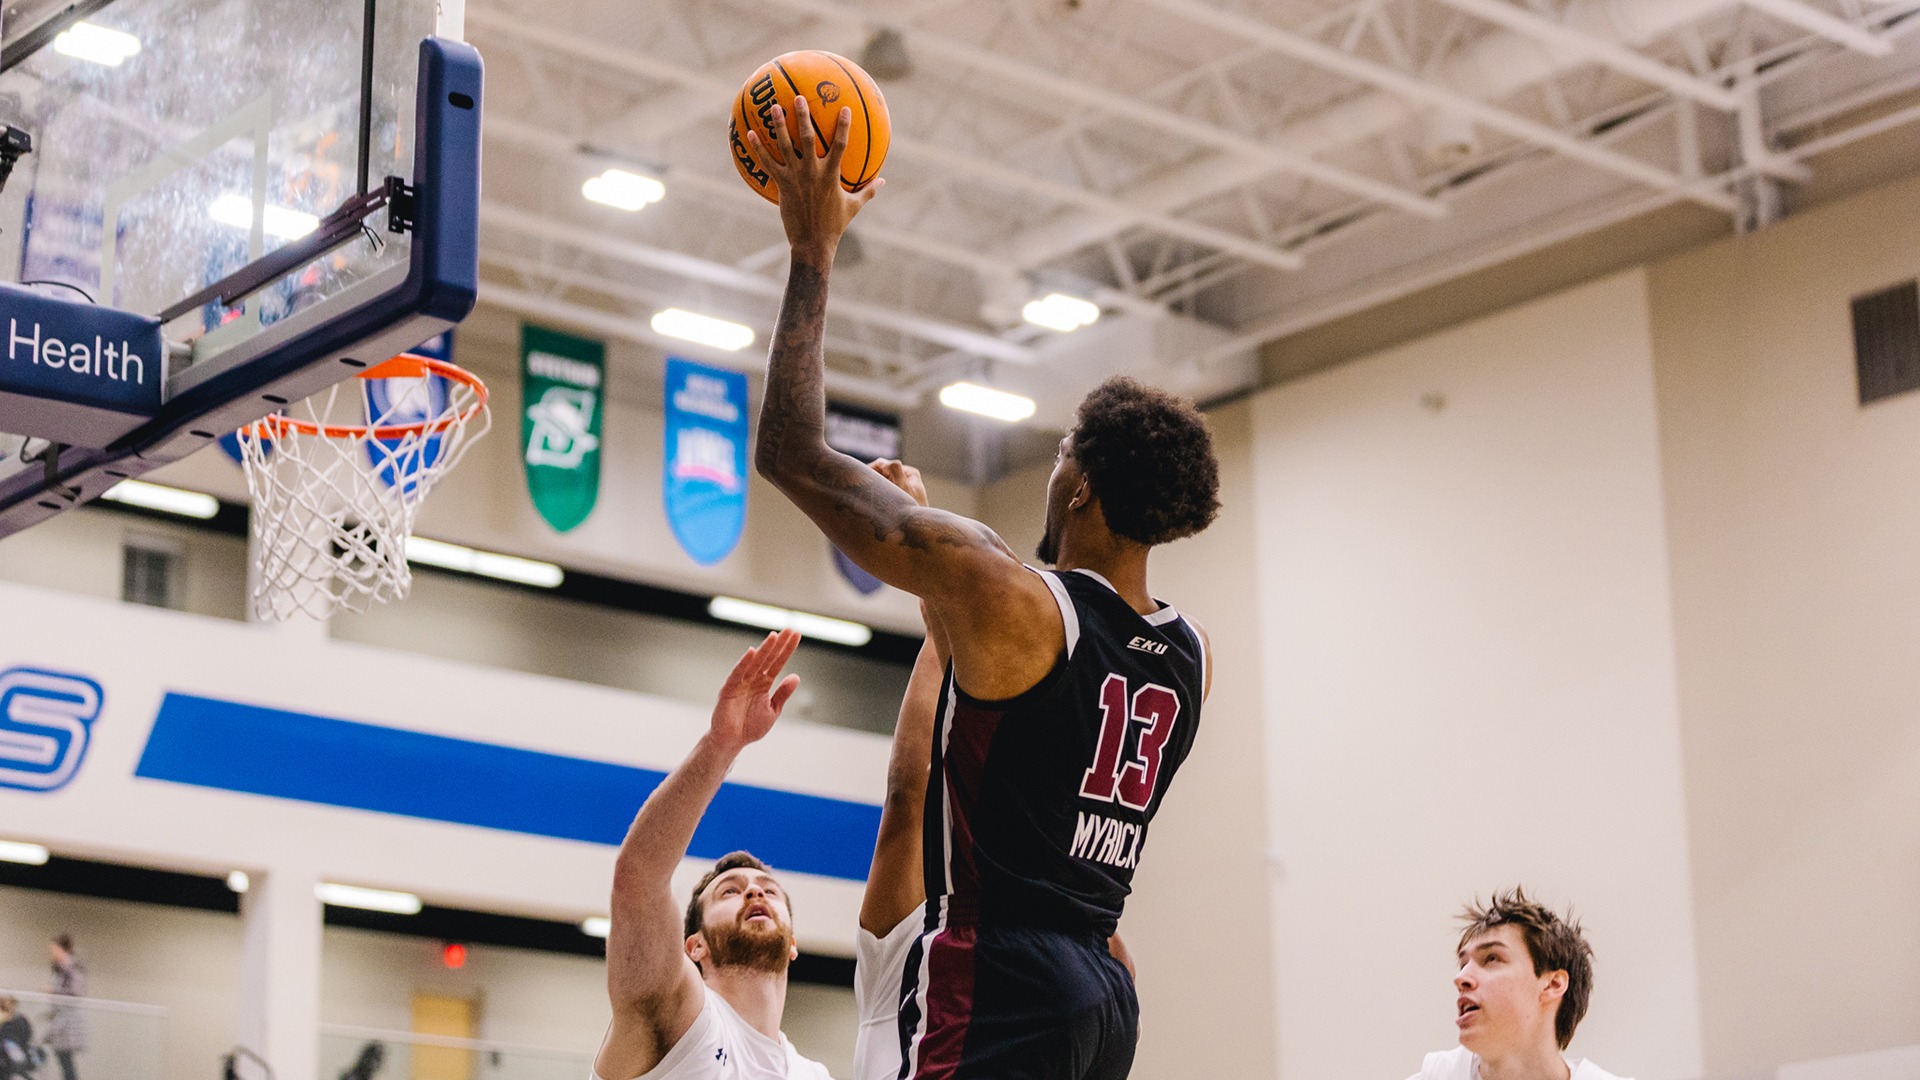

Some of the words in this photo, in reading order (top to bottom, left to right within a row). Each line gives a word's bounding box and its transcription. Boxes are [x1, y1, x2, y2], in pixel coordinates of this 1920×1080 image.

[729, 118, 770, 189] NCAA
[9, 317, 144, 385] Health
[1126, 635, 1168, 656] EKU
[1078, 672, 1181, 812] 13
[1069, 811, 1142, 869] MYRICK
